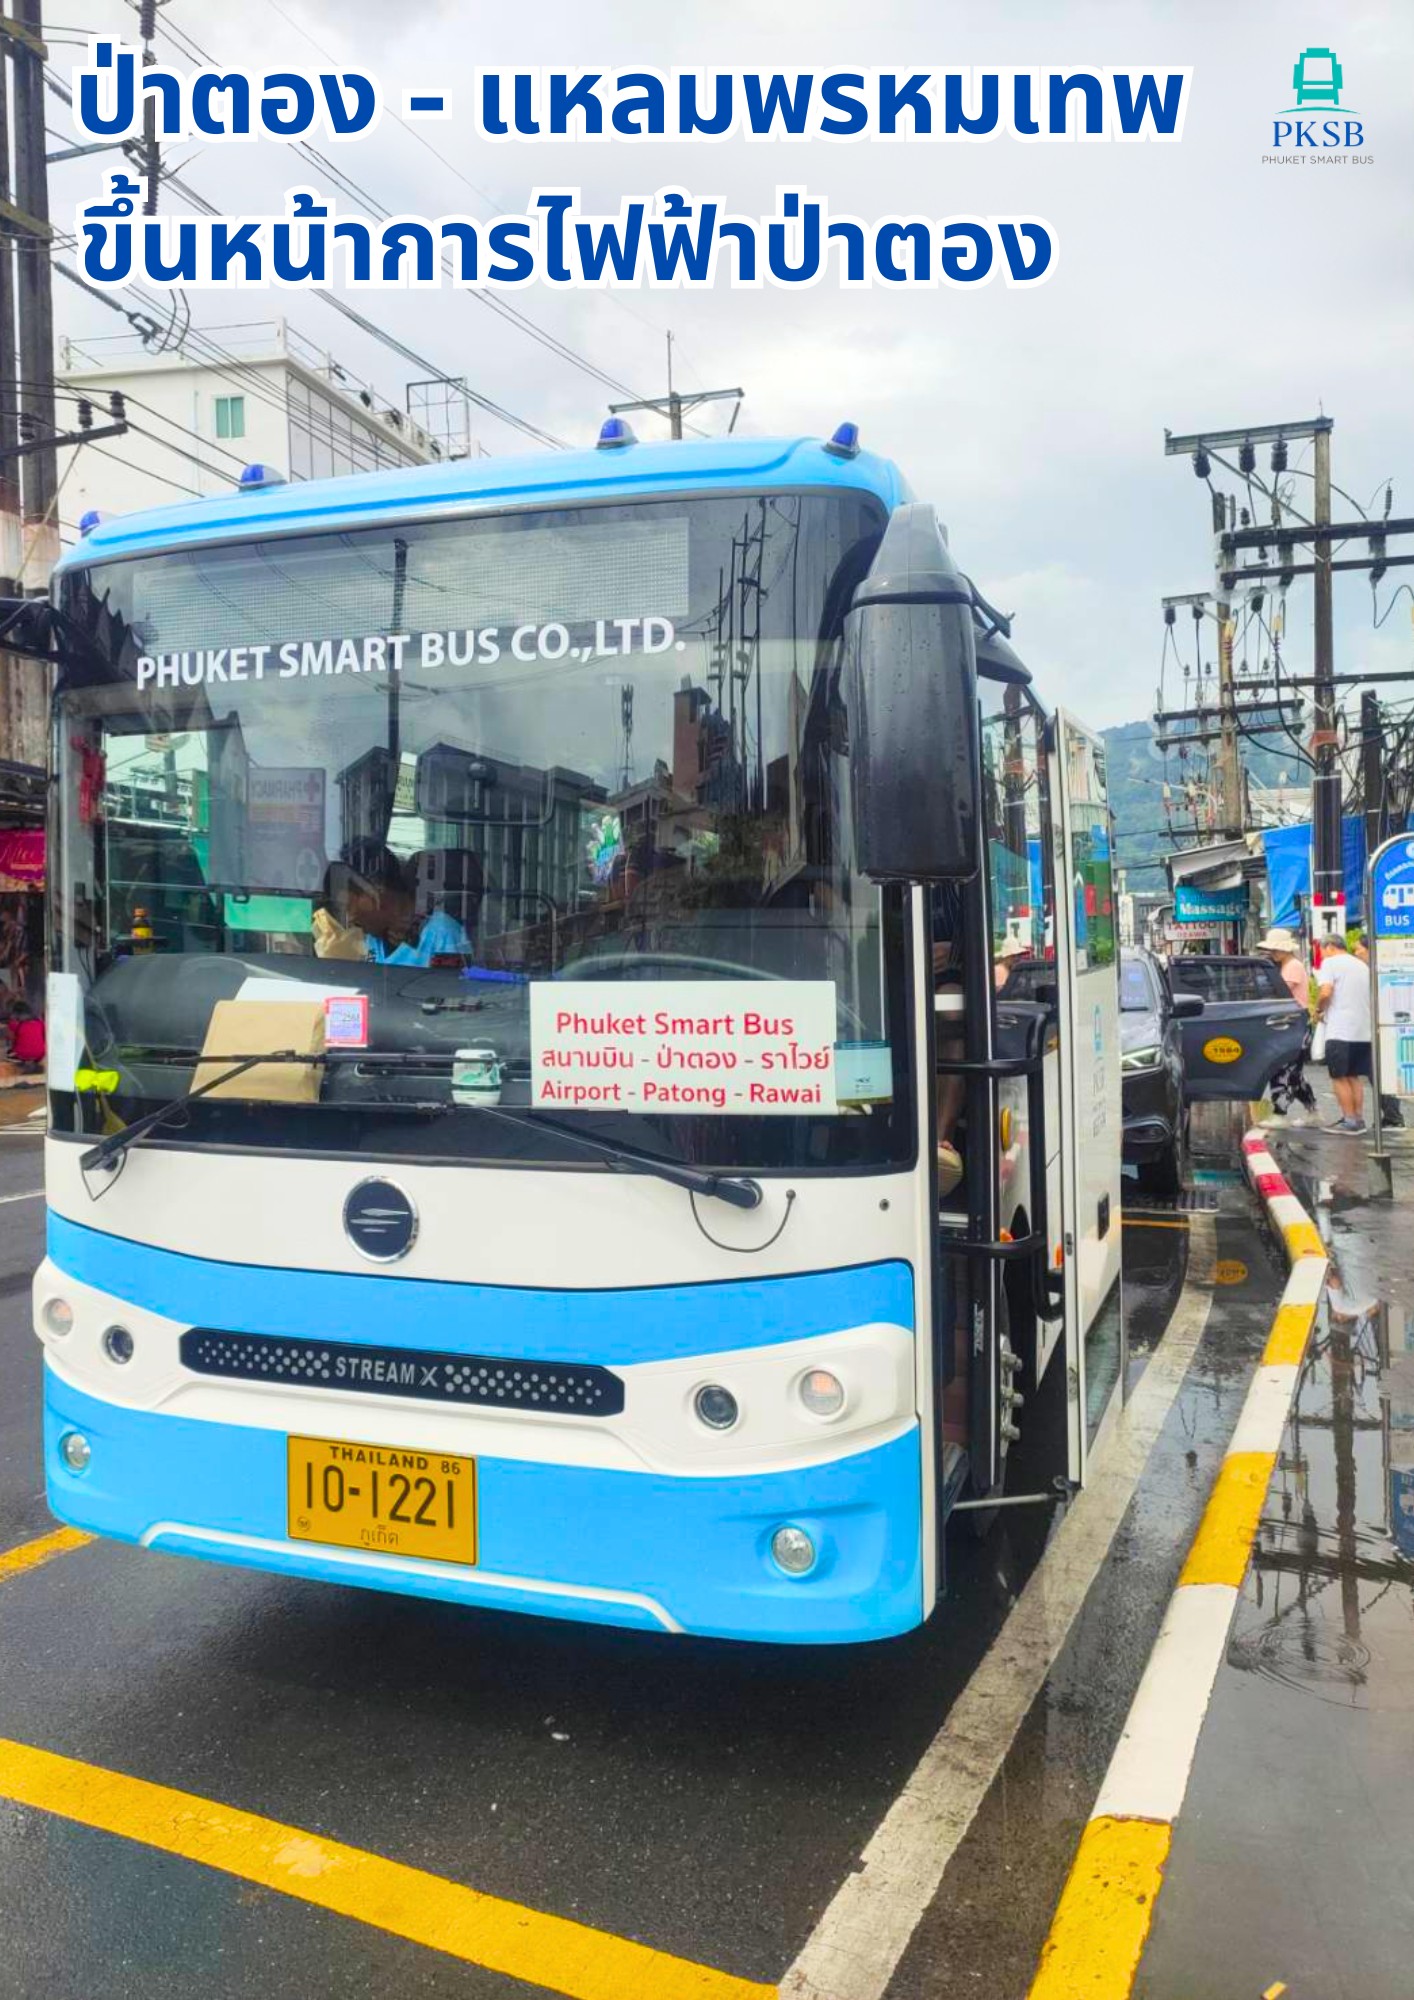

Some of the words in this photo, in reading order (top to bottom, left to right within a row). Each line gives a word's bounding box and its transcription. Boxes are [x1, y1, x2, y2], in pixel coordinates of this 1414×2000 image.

[137, 646, 271, 690] PHUKET
[279, 635, 410, 677] SMART
[421, 628, 500, 667] BUS
[511, 617, 686, 662] CO.,LTD.
[1385, 915, 1411, 927] BUS
[556, 1012, 646, 1036] Phuket
[654, 1012, 734, 1036] Smart
[744, 1012, 794, 1036] Bus
[542, 1046, 634, 1069] สนามบิน
[656, 1044, 738, 1070] ป่าตอง
[761, 1041, 830, 1070] ราไวย์
[541, 1080, 621, 1104] Airport
[643, 1082, 727, 1107] Patong
[749, 1083, 822, 1104] Rawai
[335, 1356, 415, 1385] STREAM
[329, 1446, 428, 1470] THAILAND
[441, 1460, 461, 1475] 86
[307, 1462, 454, 1529] 10-1221
